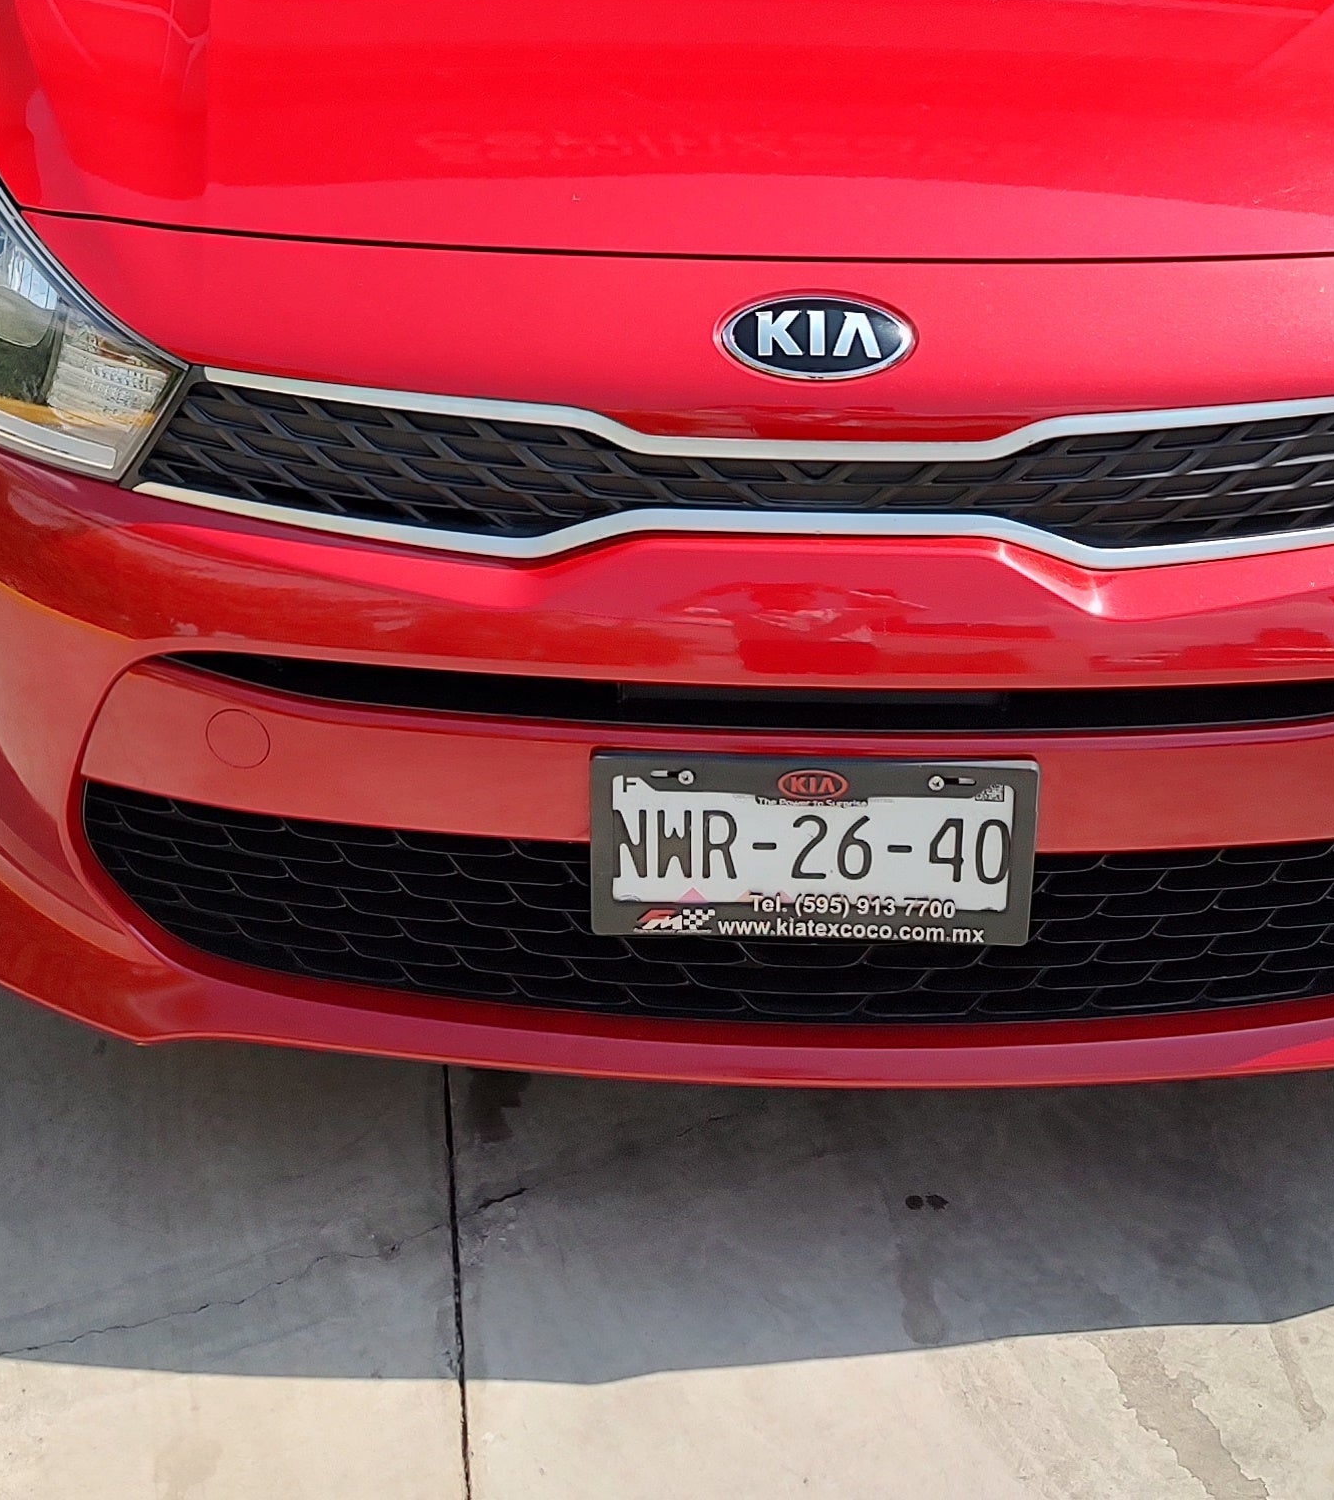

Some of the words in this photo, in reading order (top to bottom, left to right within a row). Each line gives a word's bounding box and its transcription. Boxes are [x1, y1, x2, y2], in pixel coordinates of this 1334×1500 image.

[754, 310, 883, 359] KIA
[789, 776, 837, 795] KIA
[757, 796, 778, 806] The
[778, 797, 813, 807] Power
[827, 798, 868, 809] Surprise
[613, 808, 1013, 886] NWR-26-40
[749, 894, 788, 914] Tel.
[794, 895, 850, 919] (595)
[855, 896, 896, 917] 913
[903, 898, 957, 919] 7700
[717, 916, 985, 944] www.kiatexcoco.com.mx
